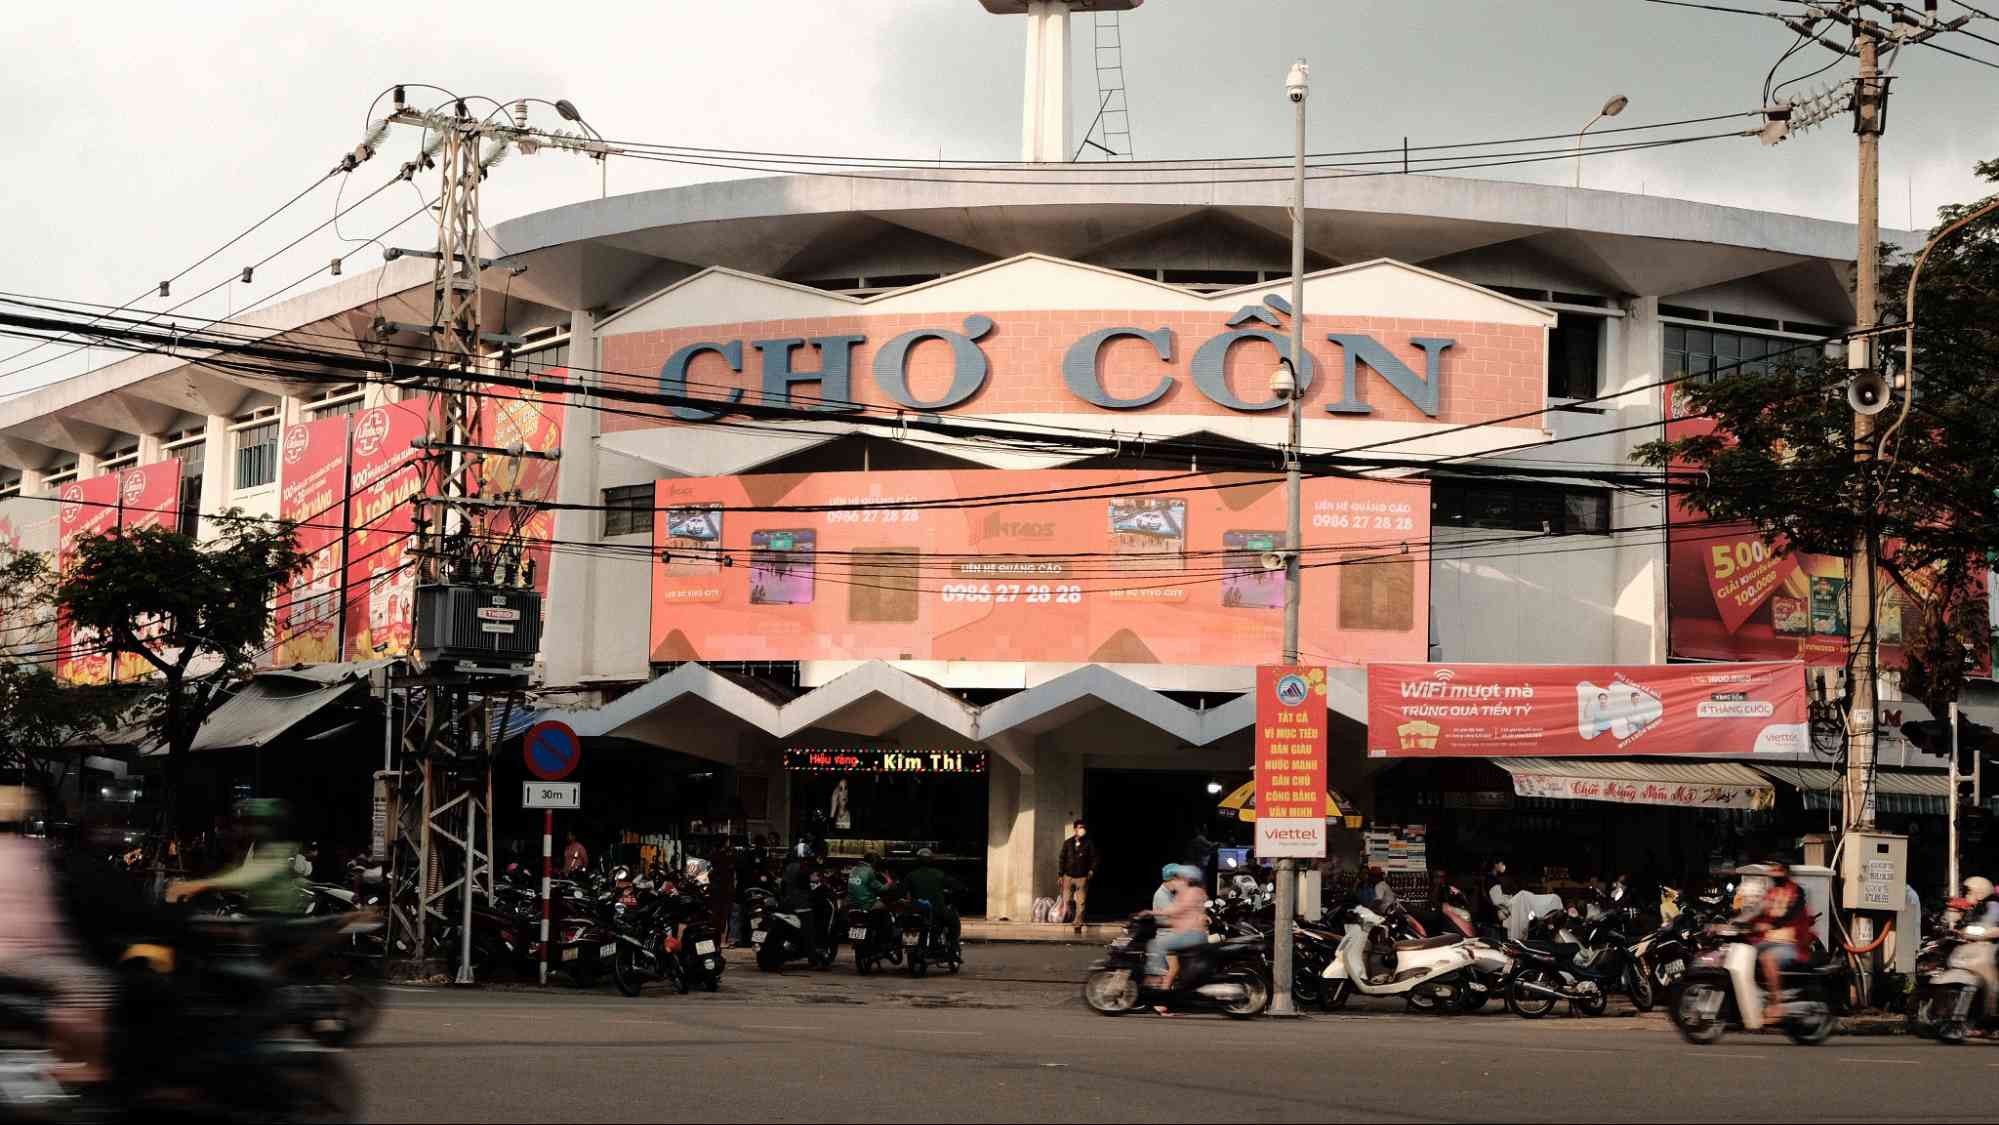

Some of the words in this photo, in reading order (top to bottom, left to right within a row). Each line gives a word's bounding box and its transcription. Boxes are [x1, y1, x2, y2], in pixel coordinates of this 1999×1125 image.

[659, 314, 993, 424] CHỢ
[1062, 293, 1456, 418] CỒN
[863, 509, 880, 523] 27
[1312, 514, 1349, 528] 0986
[1352, 515, 1369, 529] 27
[1374, 517, 1391, 529] 28
[1395, 517, 1413, 530] 28
[942, 584, 992, 603] 0986
[995, 584, 1020, 603] 27
[1025, 584, 1051, 603] 28
[1055, 585, 1081, 603] 28
[1401, 681, 1447, 699] WiFi
[1450, 683, 1501, 701] mượt
[1504, 682, 1534, 699] mà
[1401, 703, 1448, 717] TRÚNG
[1450, 703, 1480, 717] QUÀ
[884, 753, 922, 769] Kim
[930, 753, 962, 770] Thi
[542, 789, 563, 800] 30m
[1264, 828, 1318, 840] viettel
